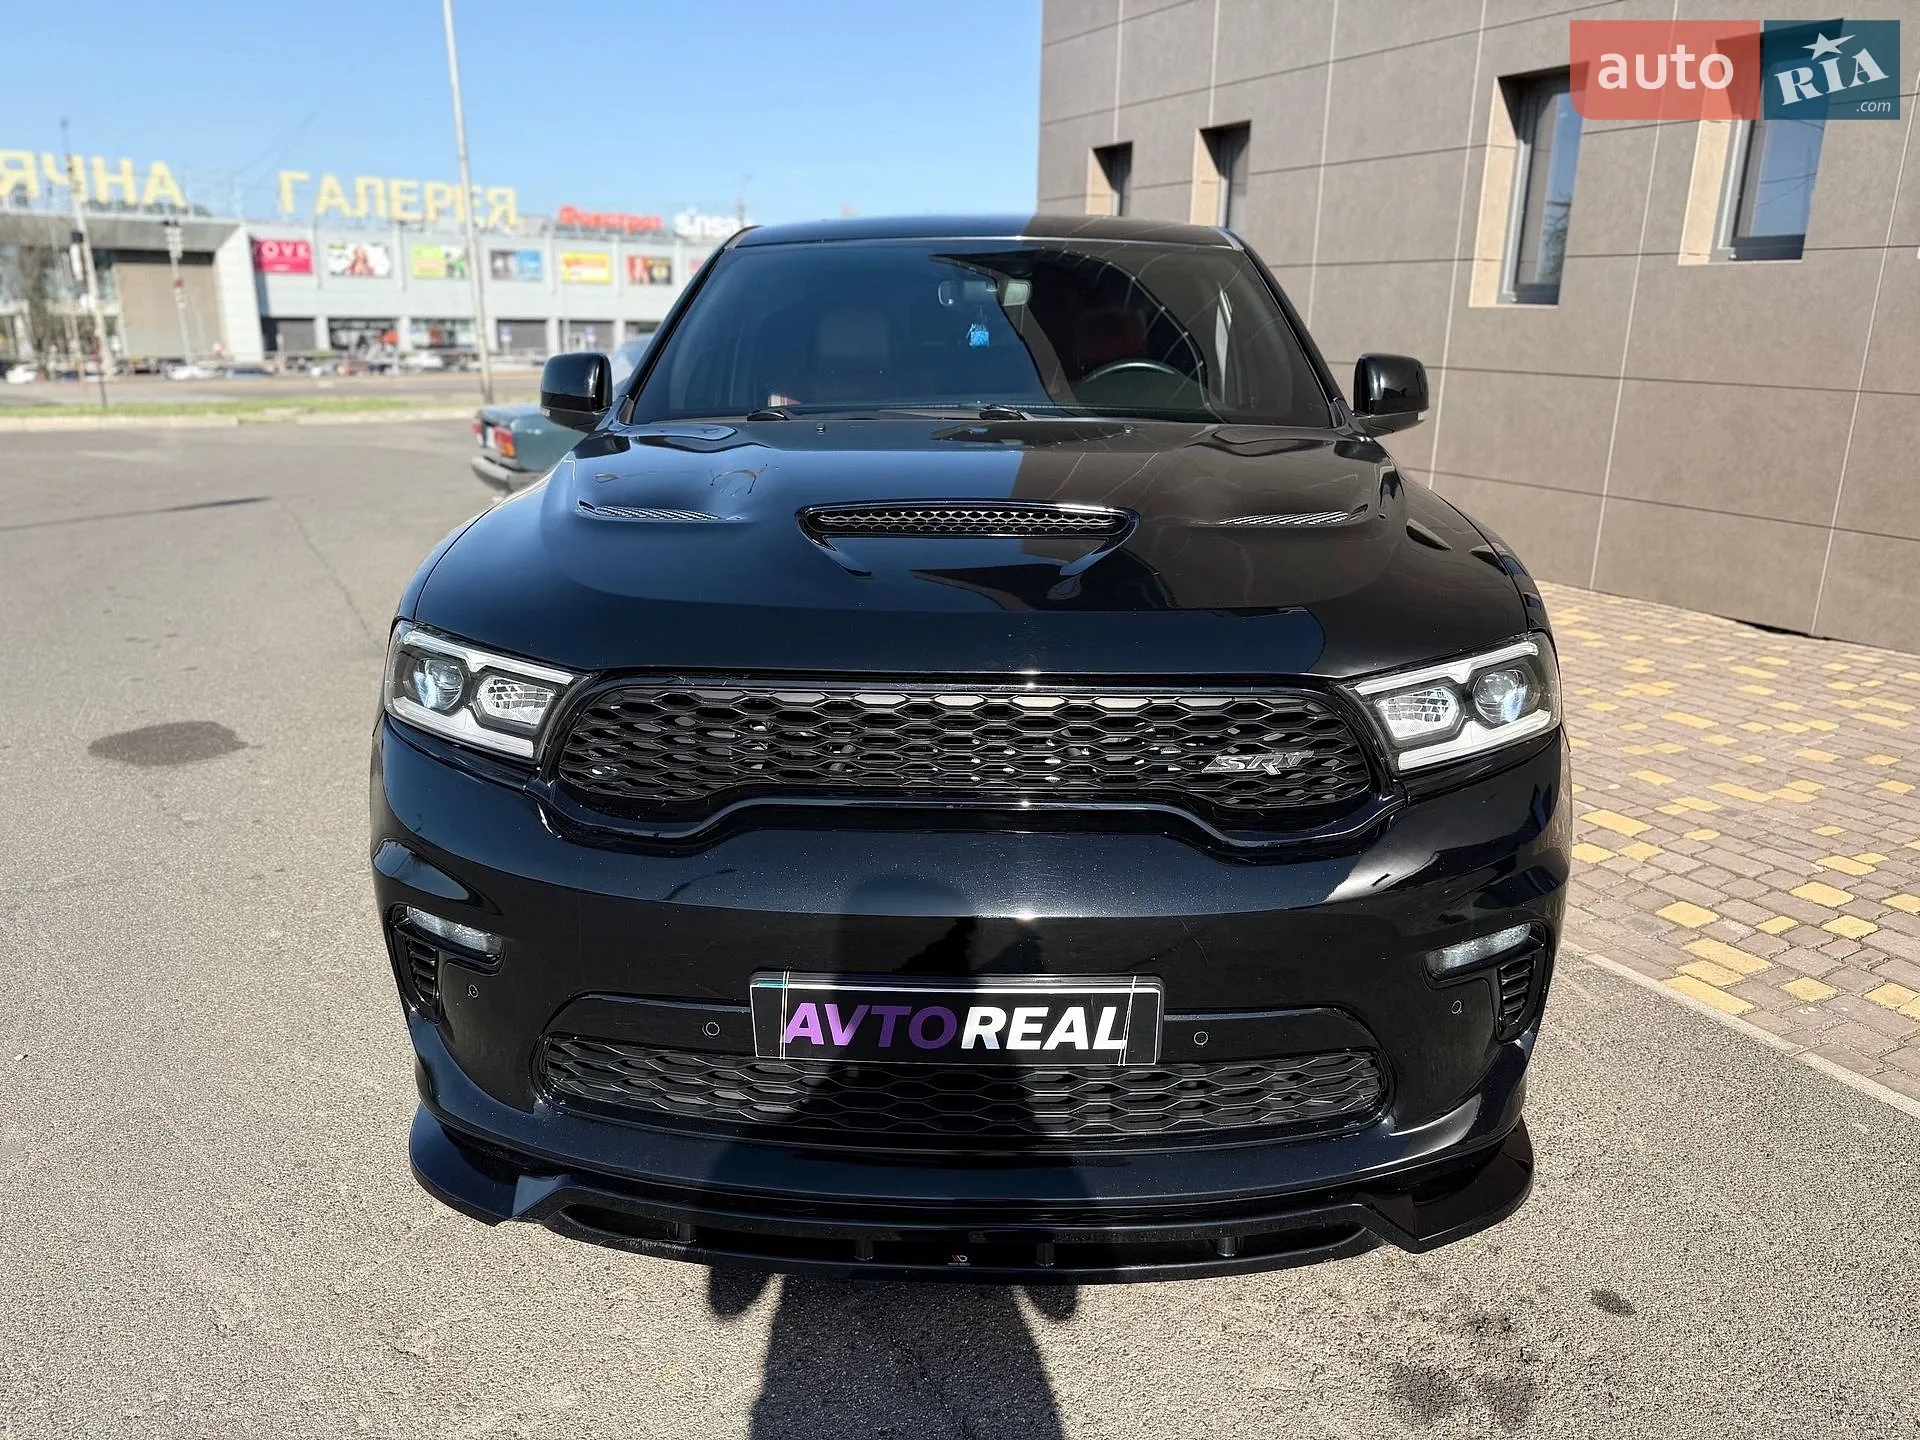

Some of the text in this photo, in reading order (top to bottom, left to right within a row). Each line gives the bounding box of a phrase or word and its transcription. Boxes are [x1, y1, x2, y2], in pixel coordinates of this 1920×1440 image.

[279, 169, 518, 229] ГАЛЕРЕЯ
[1202, 750, 1315, 776] SRT
[784, 1001, 1128, 1051] AVTOREAL
